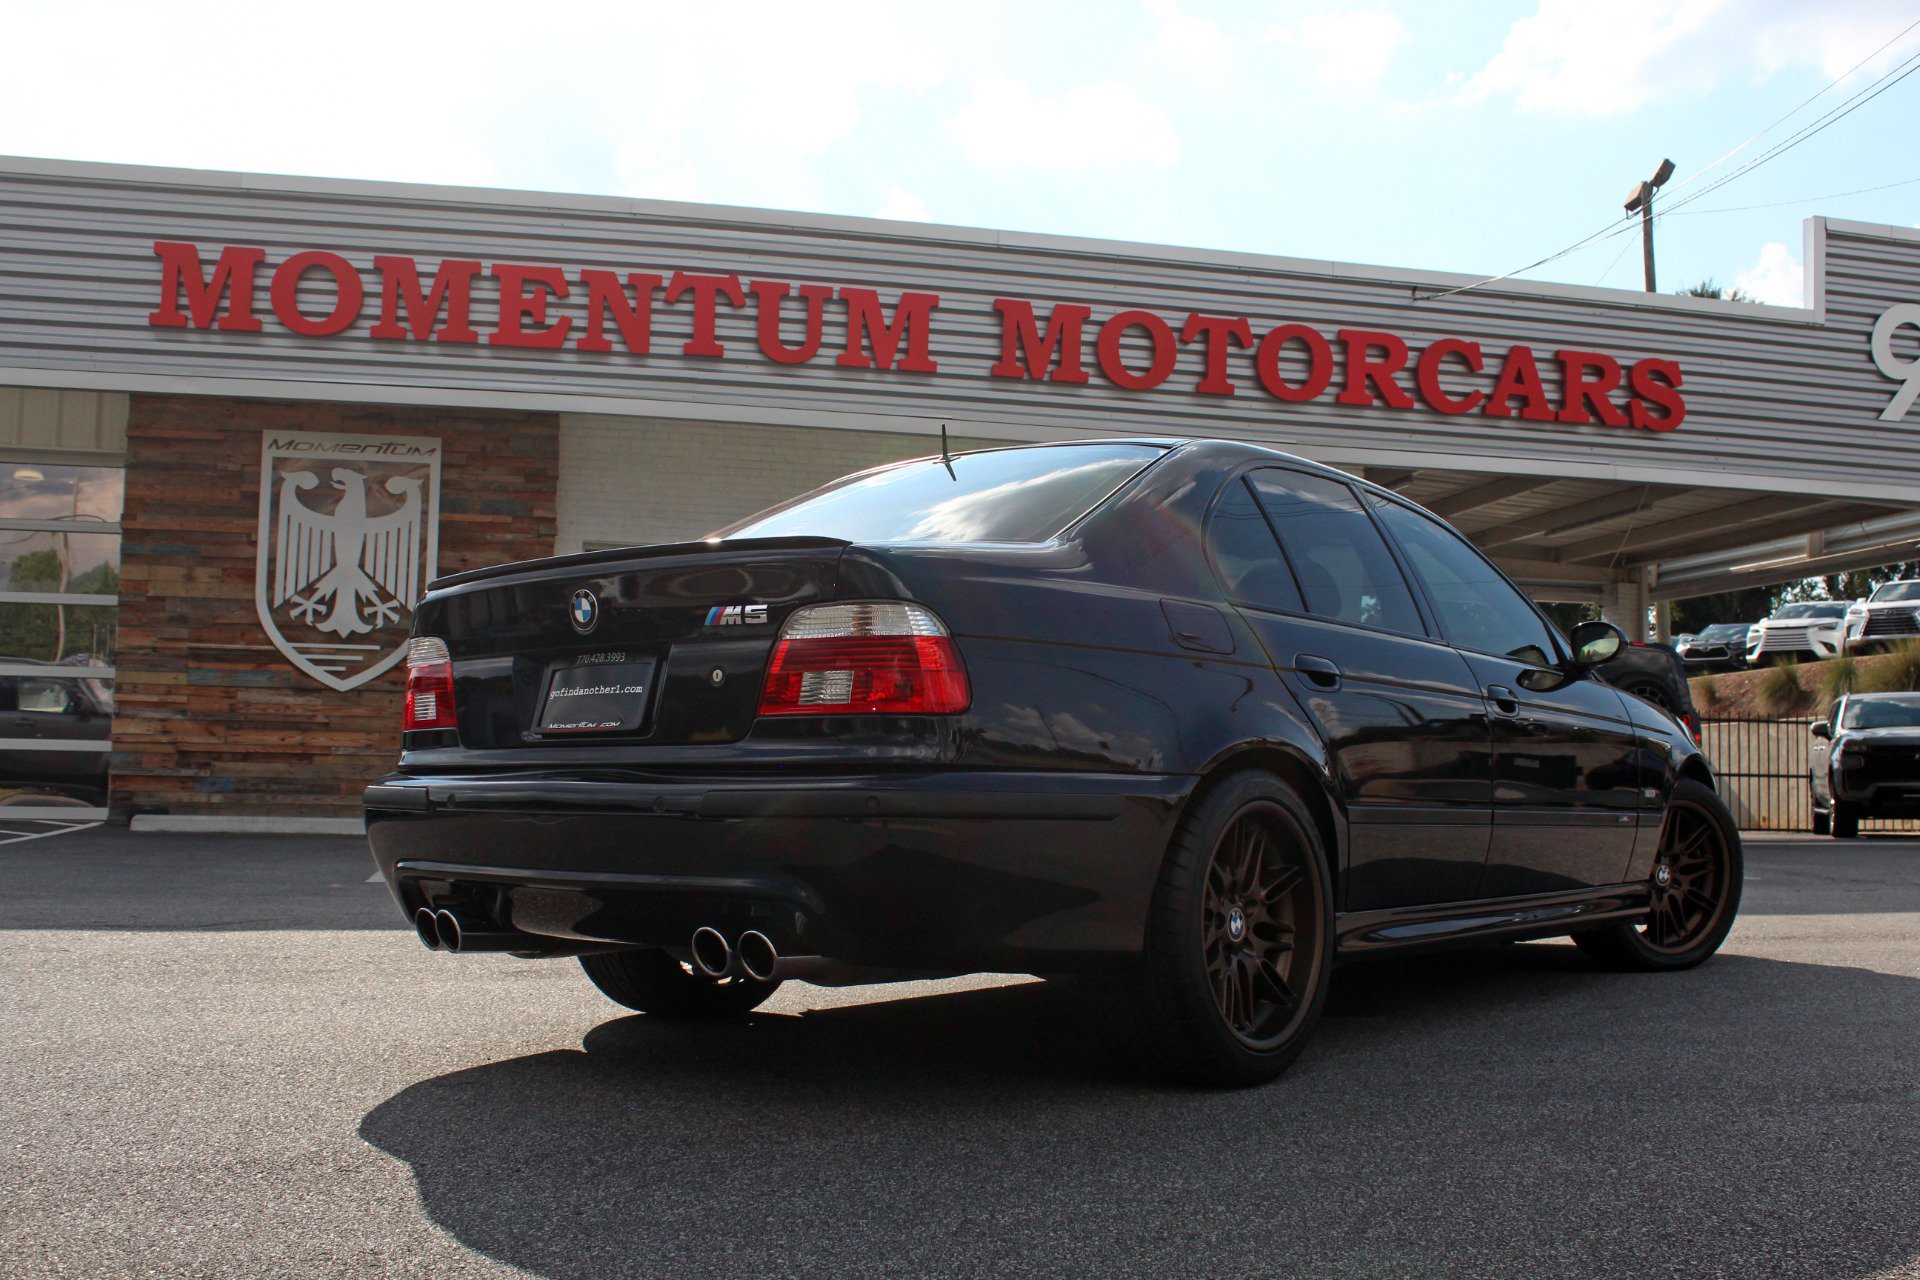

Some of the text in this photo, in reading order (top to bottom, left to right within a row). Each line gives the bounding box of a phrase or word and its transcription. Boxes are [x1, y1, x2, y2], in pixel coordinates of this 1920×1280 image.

[149, 242, 1686, 432] MOMENTUM MOTORCARS
[719, 604, 768, 625] M5
[550, 684, 643, 700] gofindanother1.com
